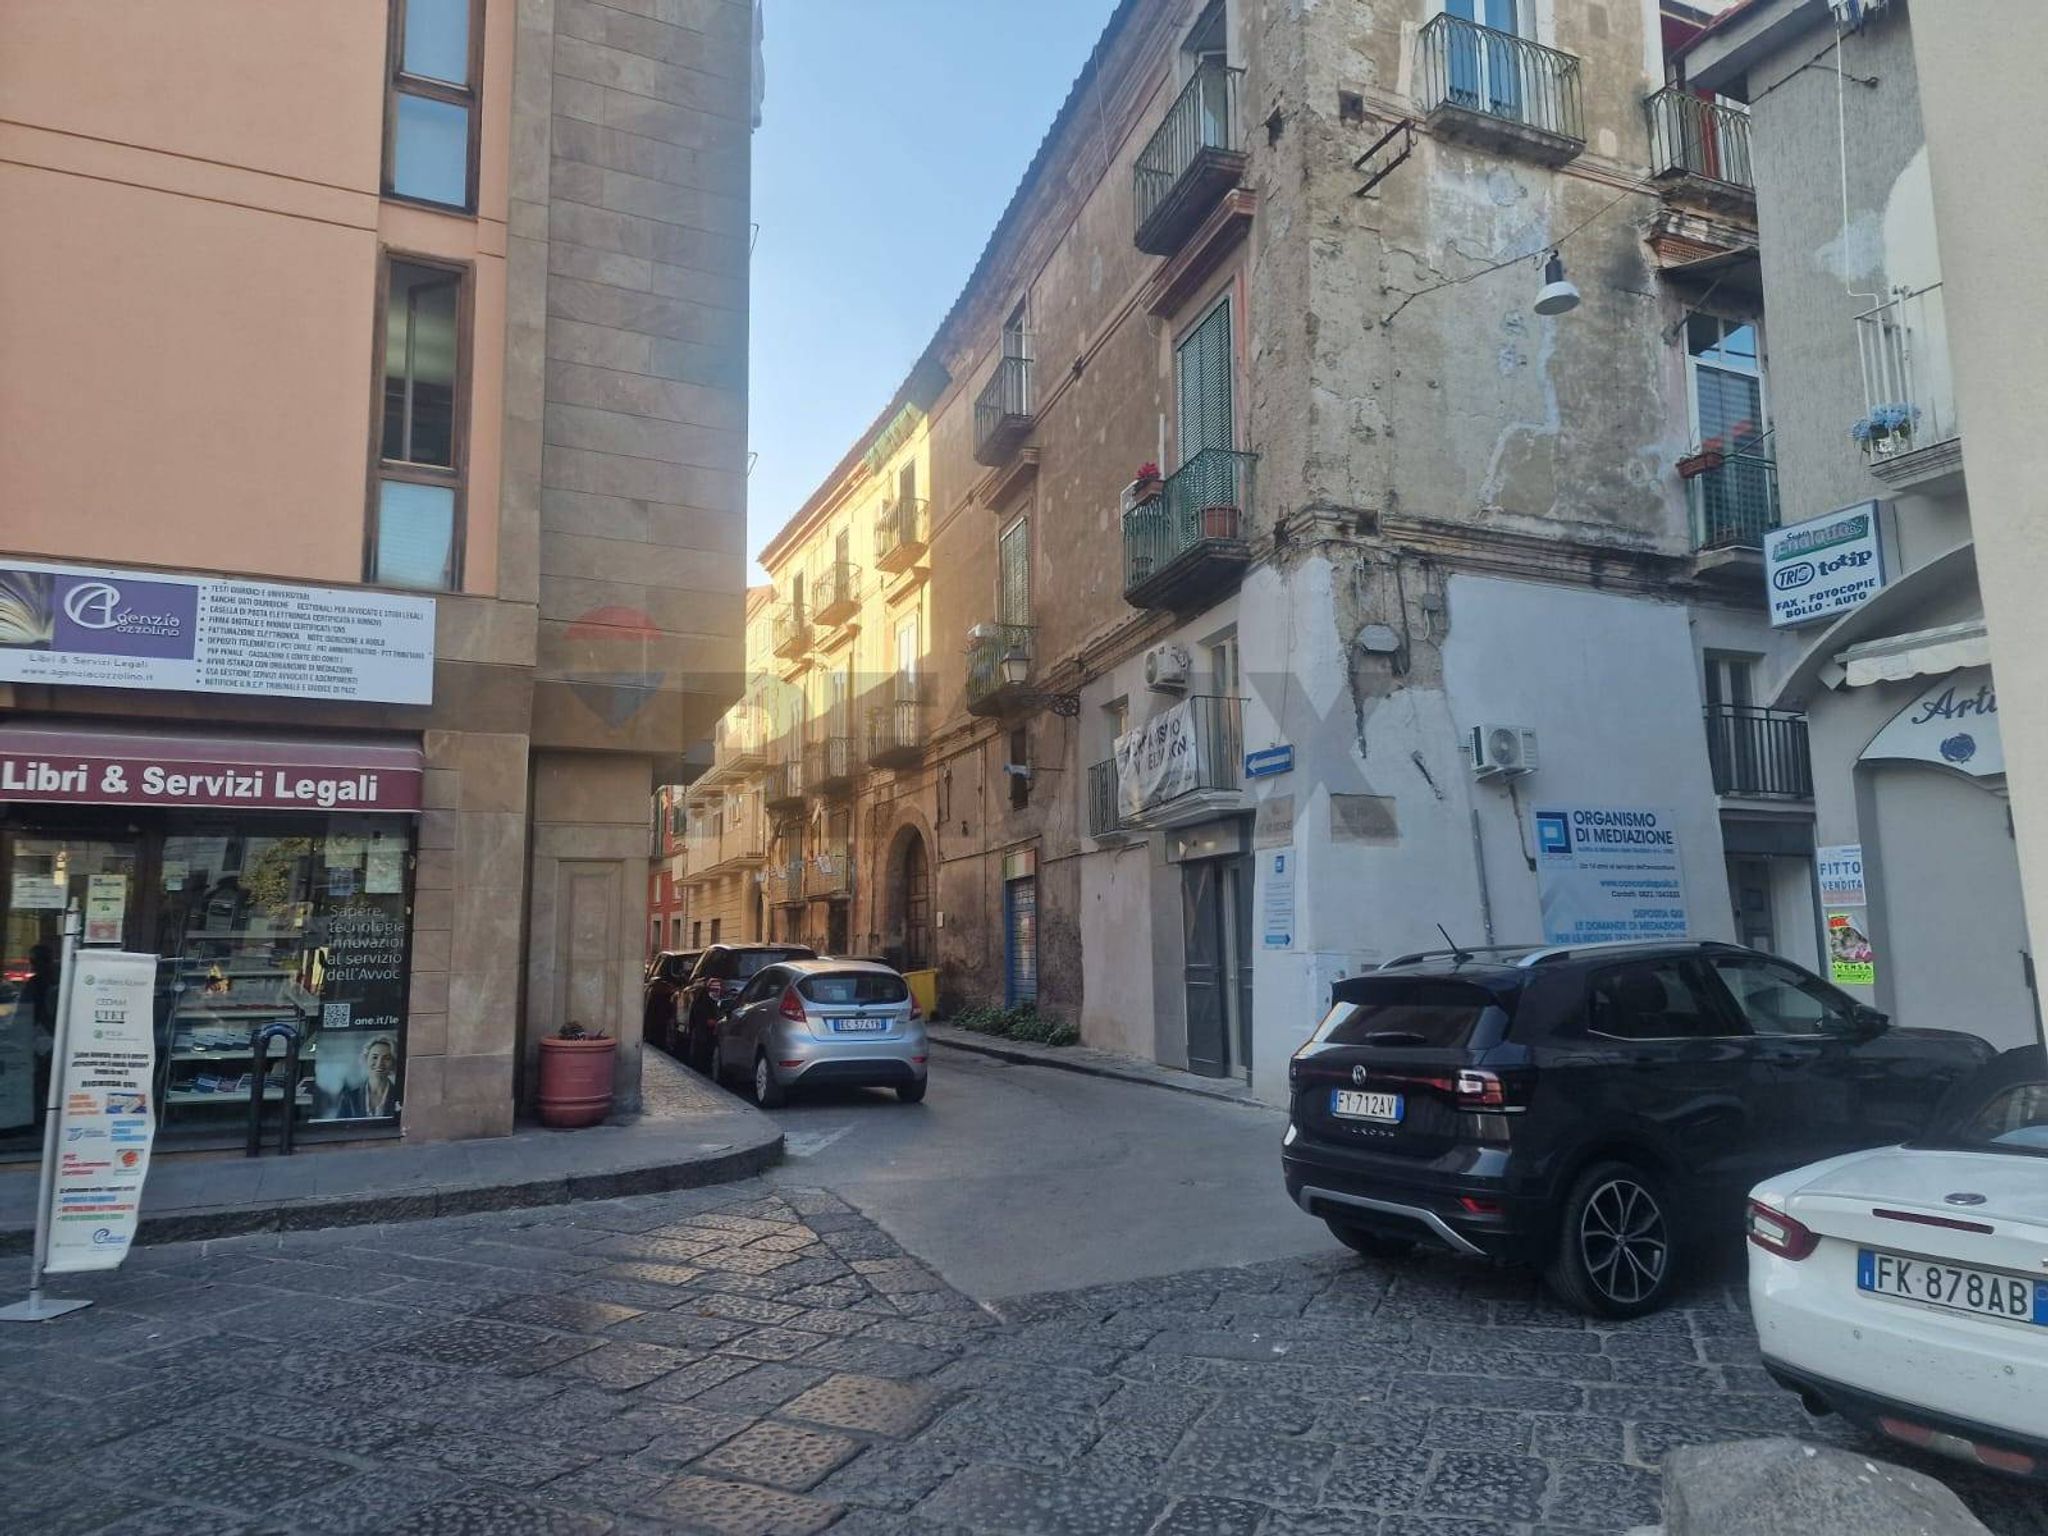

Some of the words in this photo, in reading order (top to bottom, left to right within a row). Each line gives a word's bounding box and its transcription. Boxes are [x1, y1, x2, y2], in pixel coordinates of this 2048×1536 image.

[1818, 550, 1873, 576] totip
[1775, 598, 1798, 611] FAX
[1809, 578, 1876, 602] FOTOCOPIE
[1785, 603, 1823, 618] BOLLO
[1834, 591, 1868, 606] AUTO
[2, 761, 88, 793] Libri
[101, 764, 130, 794] &
[142, 765, 264, 798] Servizi
[275, 771, 379, 807] Legali
[1573, 810, 1656, 827] ORGANISMO
[1576, 828, 1590, 842] DI
[1593, 828, 1674, 845] MEDIAZIONE
[1819, 861, 1861, 876] FITTO
[1821, 879, 1863, 891] VENDITA
[327, 953, 340, 966] al
[346, 950, 403, 967] servizio
[1877, 1256, 1912, 1294] FK
[1926, 1267, 2028, 1316] 878AB
